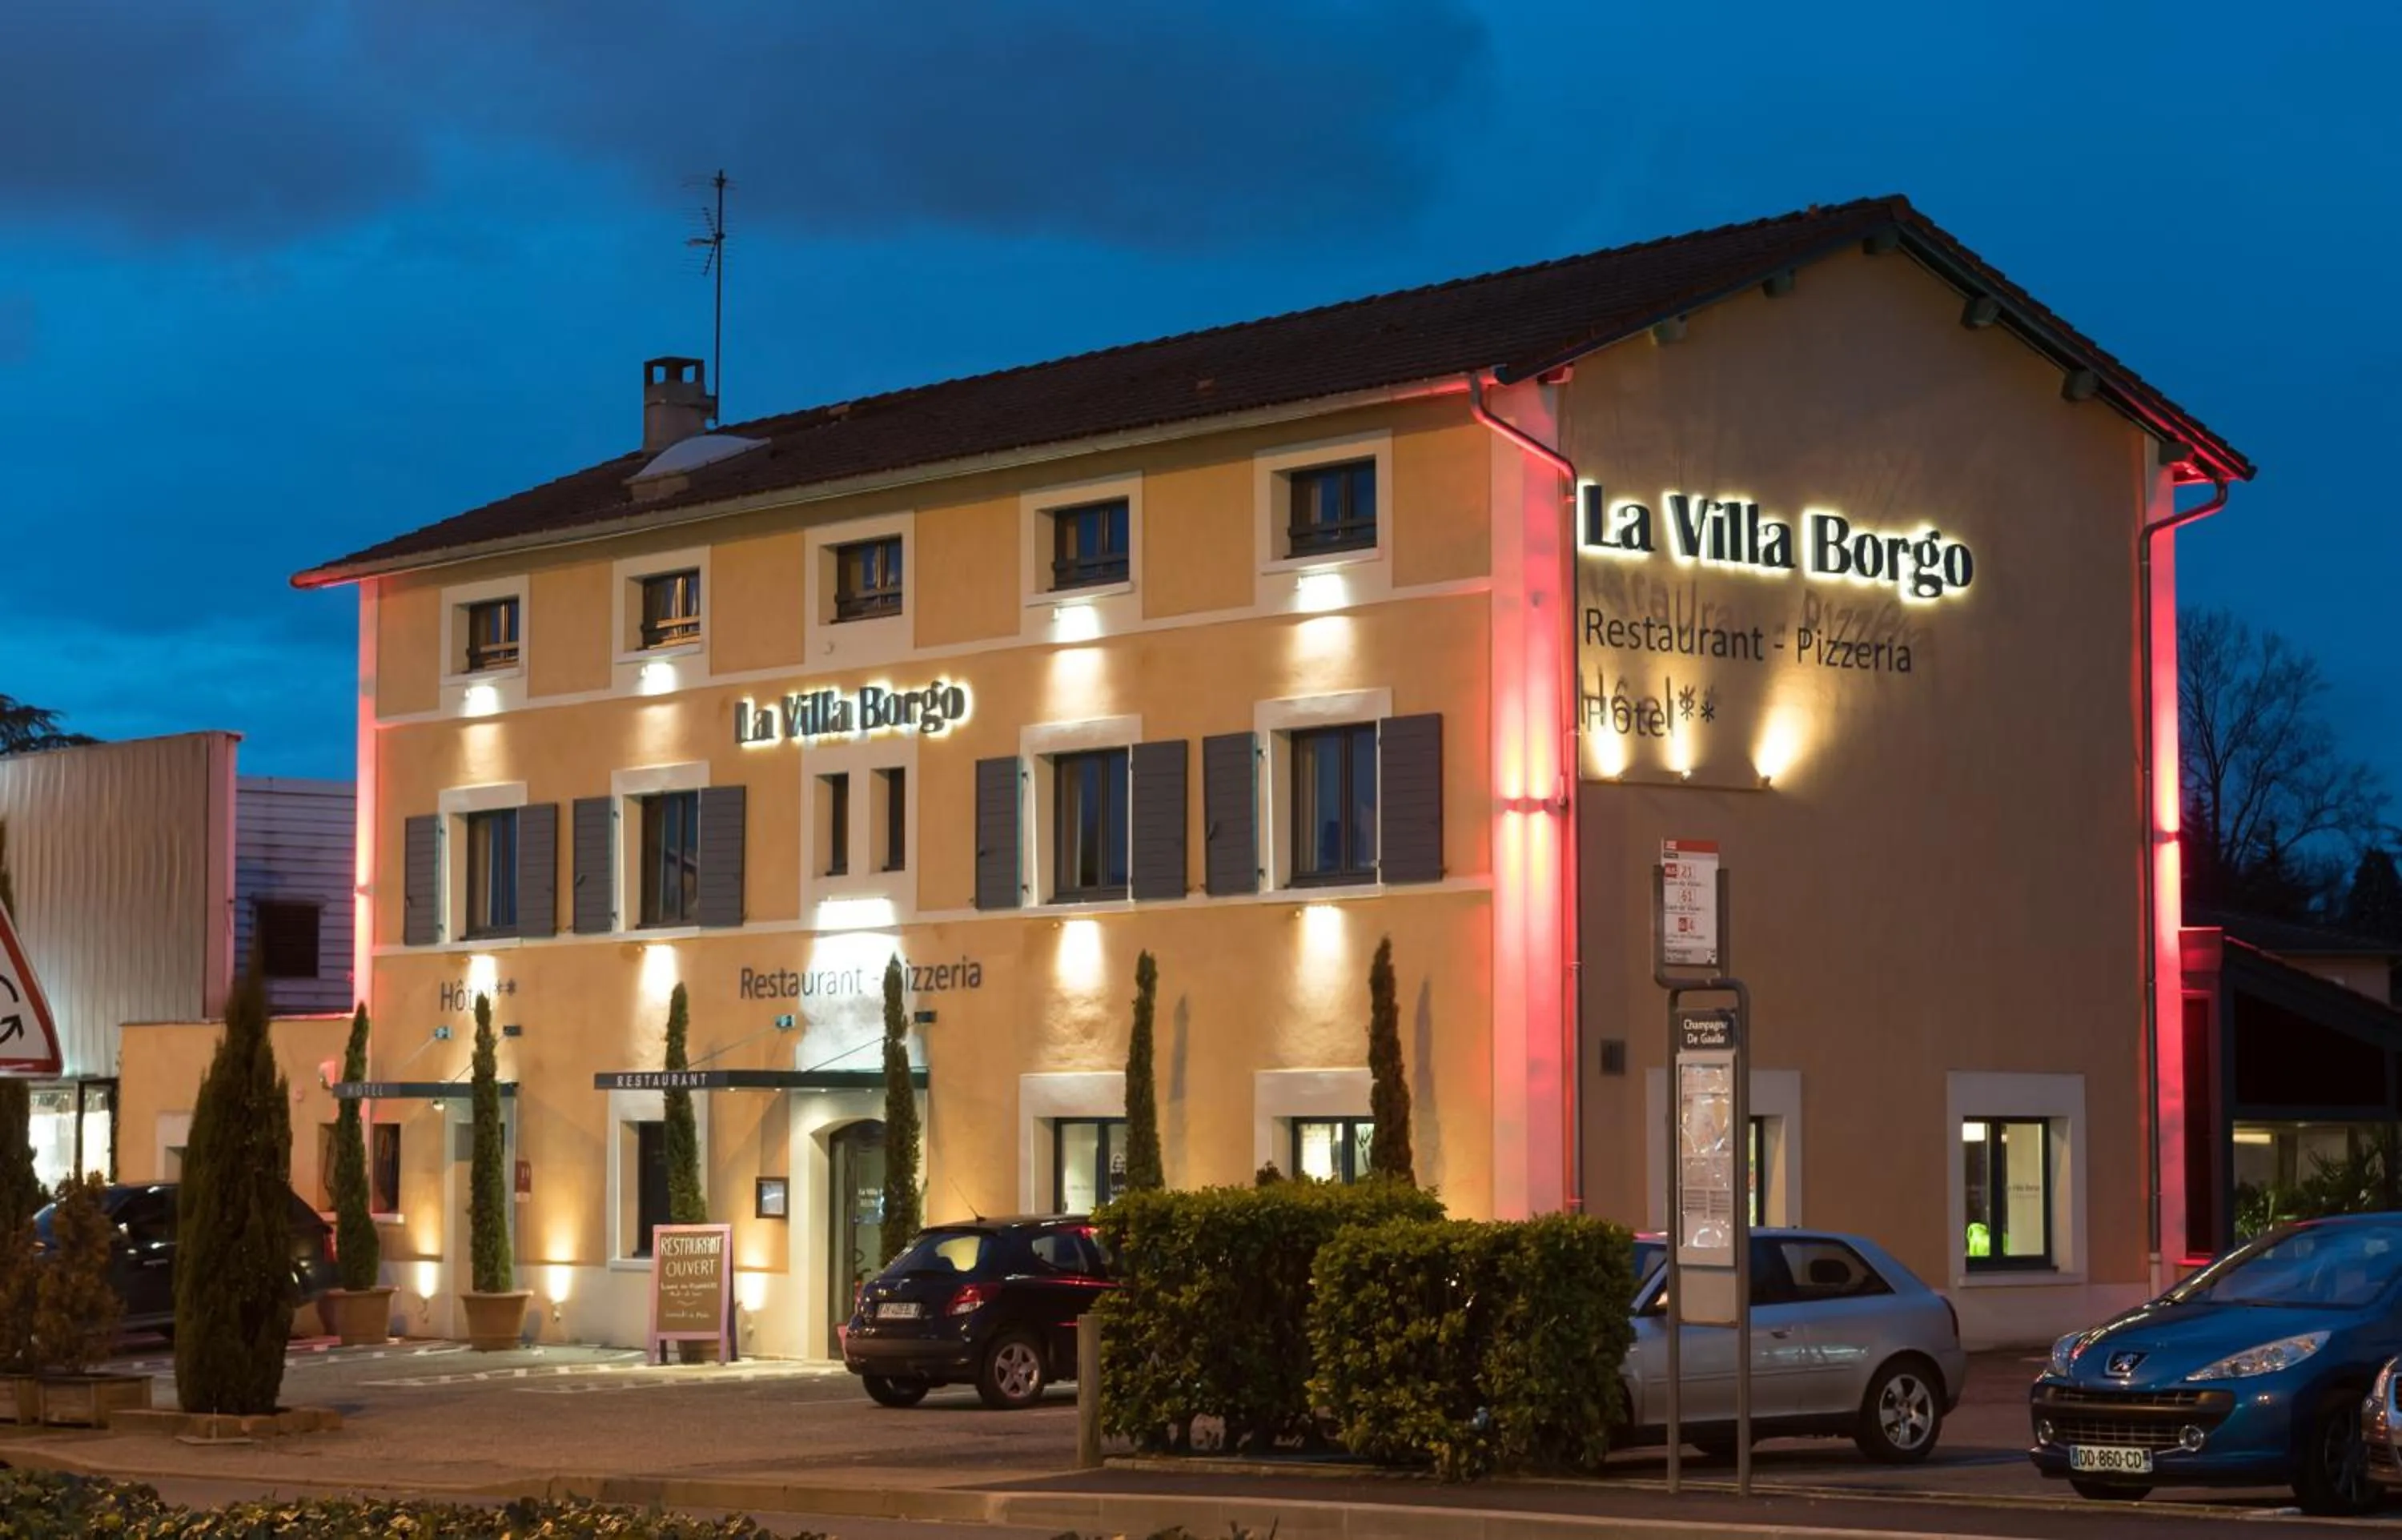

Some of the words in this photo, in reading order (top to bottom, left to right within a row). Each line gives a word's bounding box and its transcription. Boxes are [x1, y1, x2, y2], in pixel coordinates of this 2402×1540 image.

[1582, 483, 1654, 554] La
[1668, 492, 1796, 570] Villa
[1809, 513, 1974, 599] Borgo
[1585, 608, 1765, 662] Restaurant
[1797, 627, 1912, 673] Pizzeria
[734, 701, 775, 744] La
[781, 689, 854, 738] Villa
[859, 680, 966, 734] Borgo
[740, 967, 864, 1000] Restaurant
[904, 955, 982, 993] izzeria
[616, 1073, 708, 1088] RESTAURANT
[660, 1235, 722, 1257] RESTAURANT
[665, 1259, 716, 1278] OUVERT
